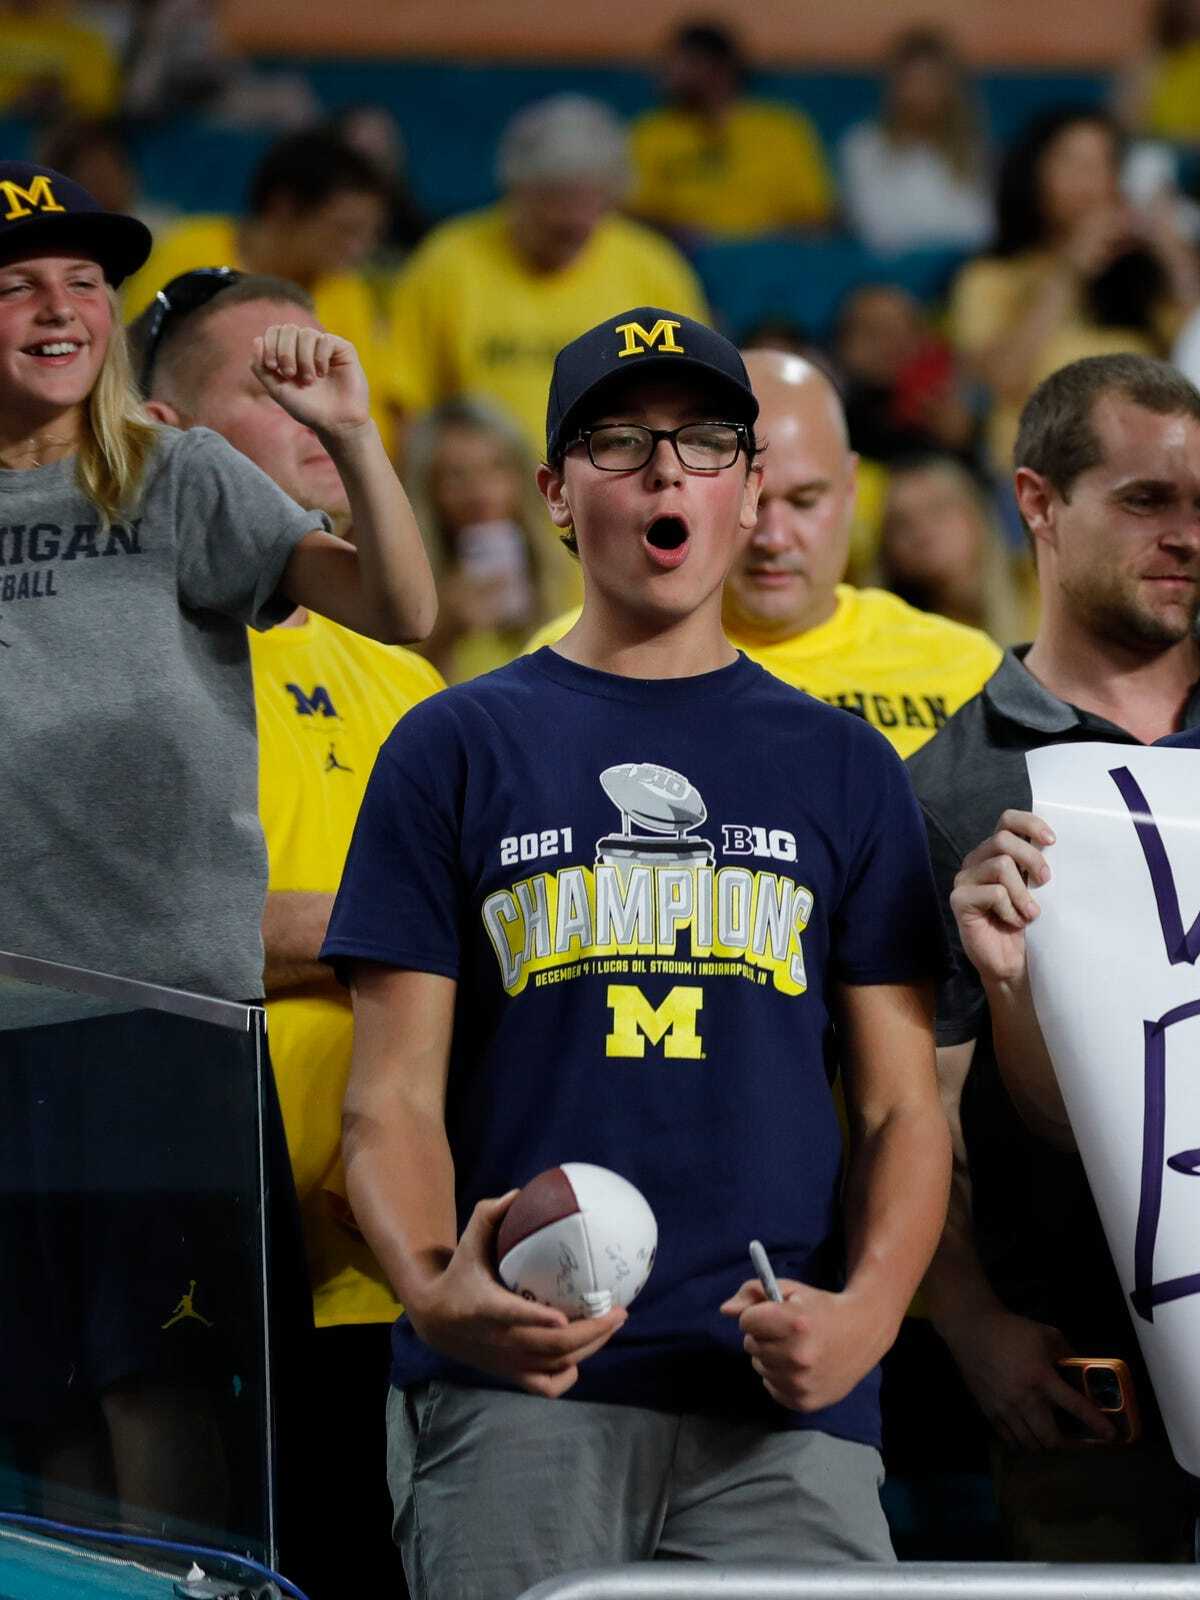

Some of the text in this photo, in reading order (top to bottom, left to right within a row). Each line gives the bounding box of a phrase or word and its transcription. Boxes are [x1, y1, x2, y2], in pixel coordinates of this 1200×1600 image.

[0, 175, 66, 220] M
[615, 319, 684, 358] M
[0, 569, 57, 602] BALL
[285, 683, 337, 718] M
[501, 827, 573, 866] 2021
[482, 865, 815, 997] CHAMPIONS
[535, 964, 582, 988] DECEMBER
[583, 961, 590, 975] 4
[597, 959, 629, 974] LUCAS
[632, 959, 647, 973] OIL
[650, 959, 692, 975] STADIUM
[606, 984, 704, 1060] M
